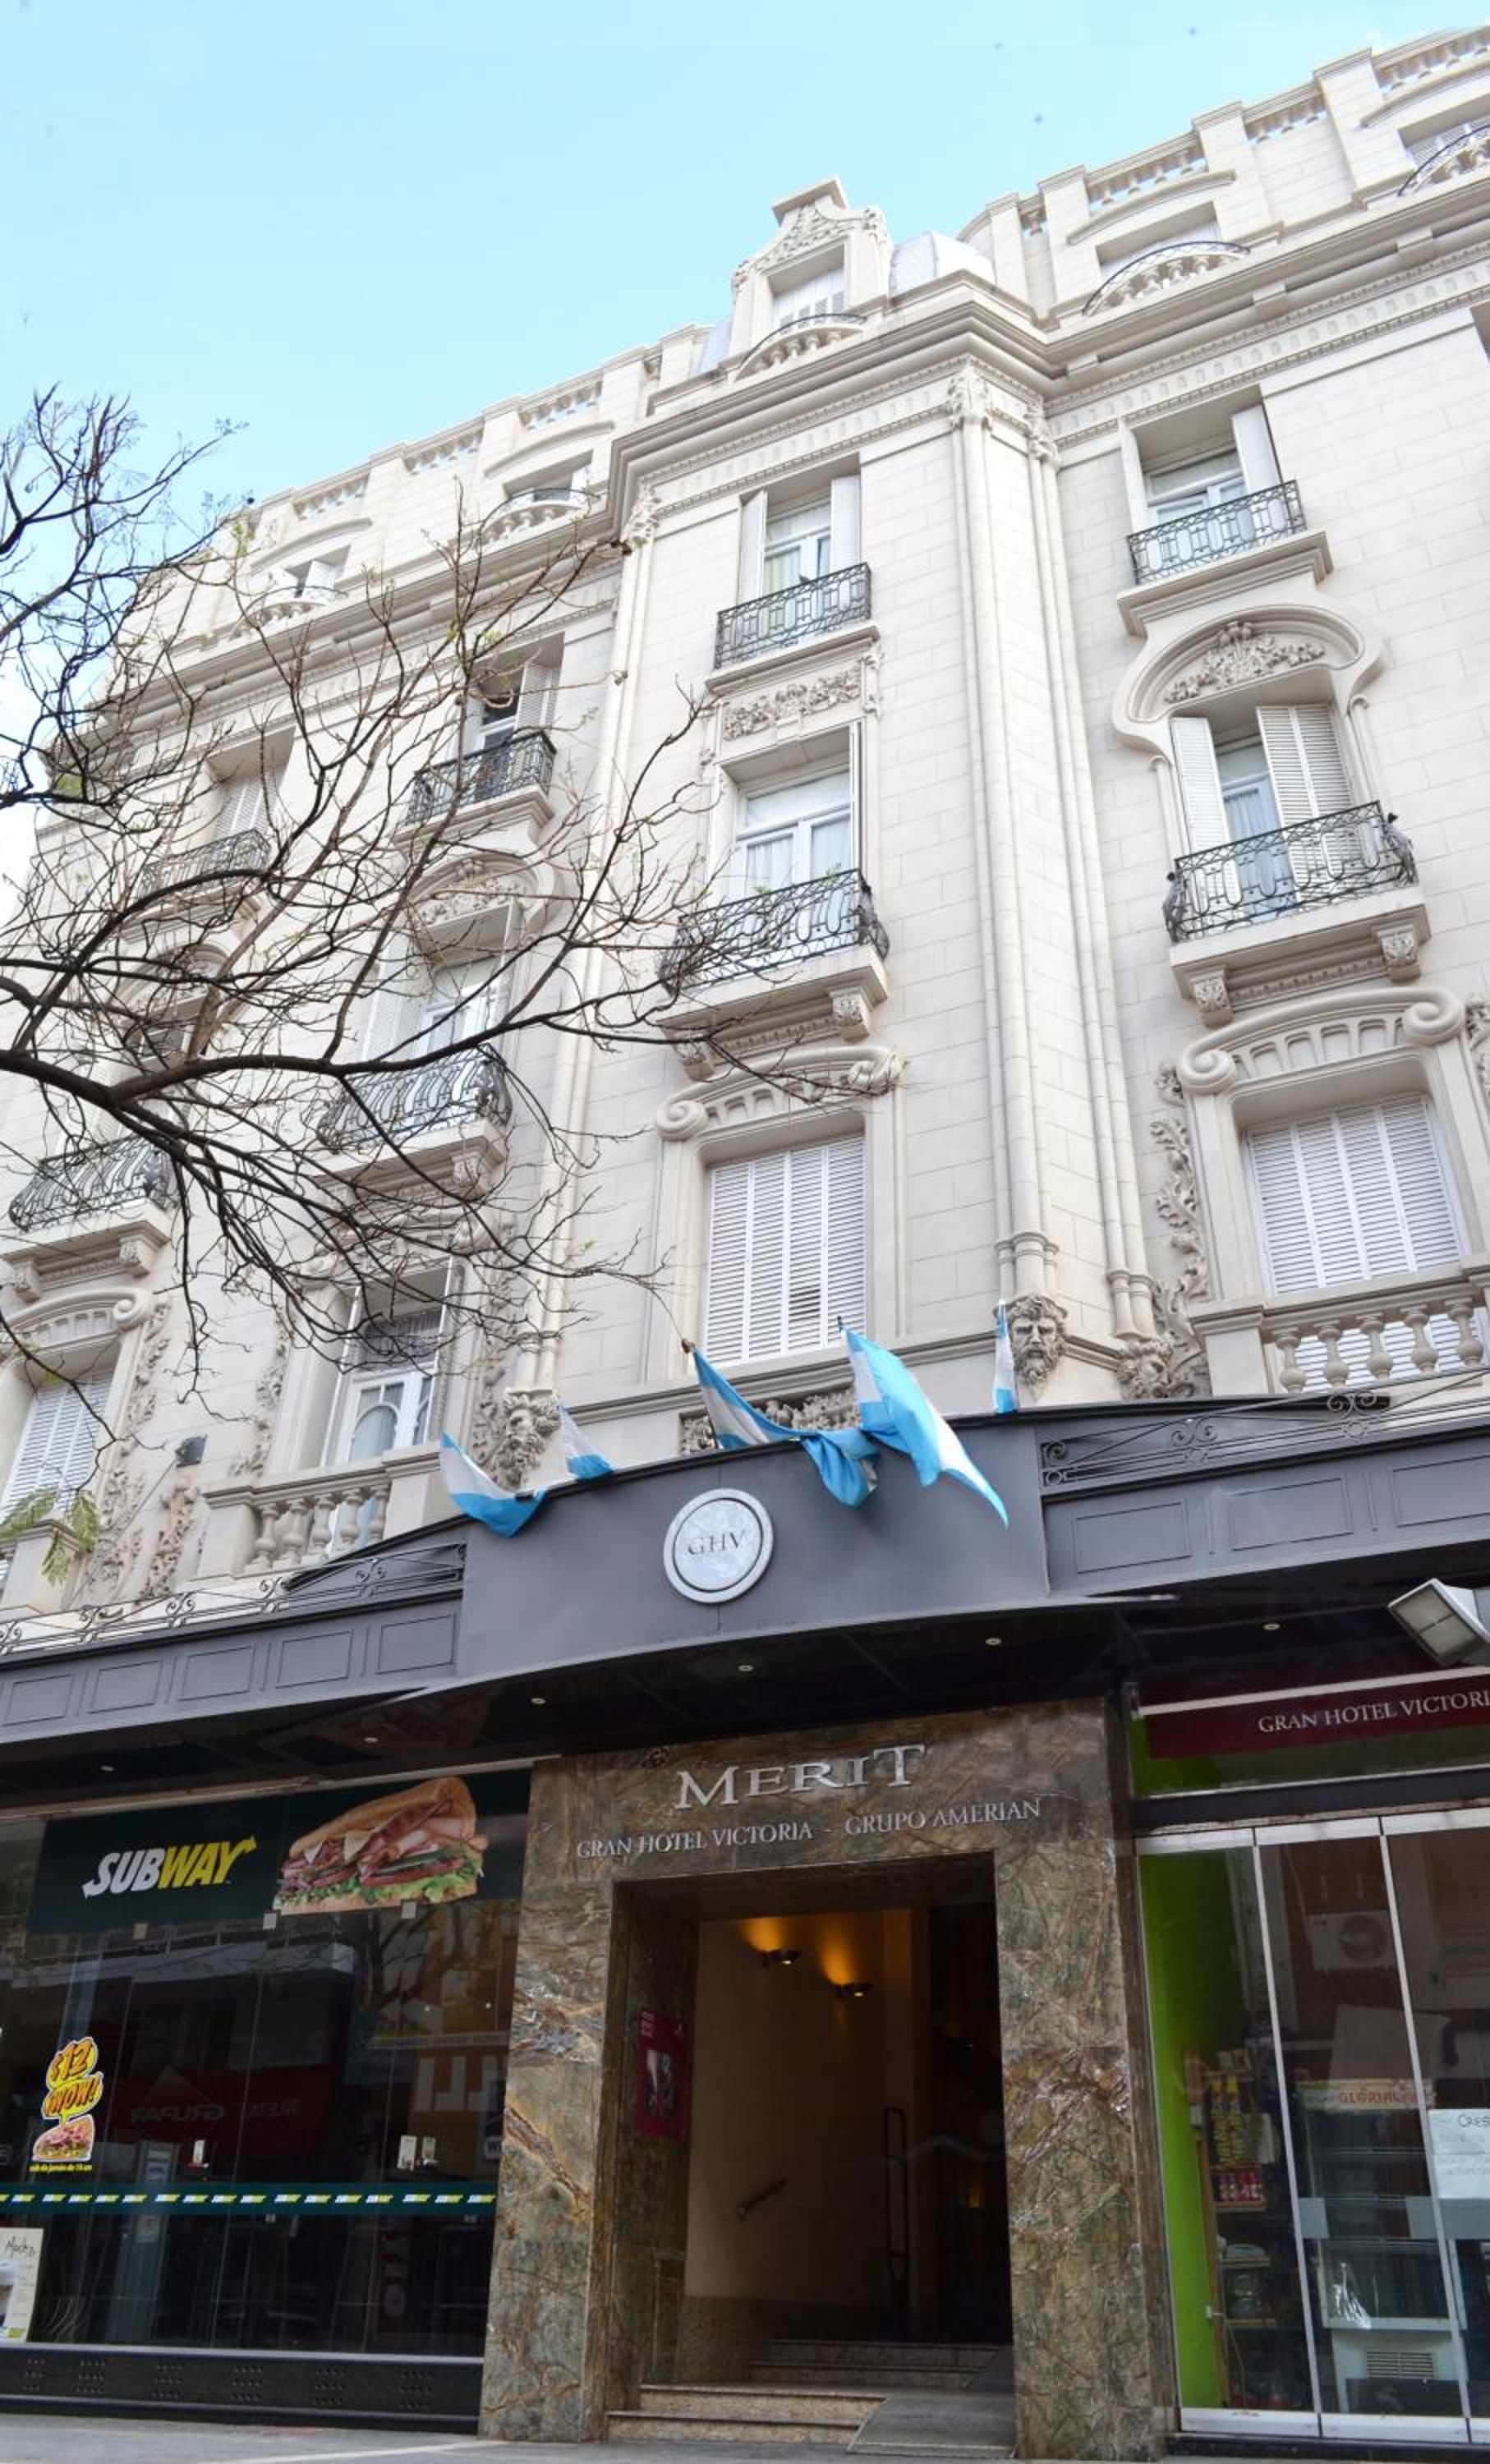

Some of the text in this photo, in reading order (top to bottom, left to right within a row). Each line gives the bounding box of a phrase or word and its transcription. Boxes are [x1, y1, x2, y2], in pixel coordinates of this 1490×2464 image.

[688, 1529, 746, 1555] GHV
[1258, 1712, 1317, 1733] GRAN
[1324, 1702, 1397, 1726] HOTEL
[673, 1743, 926, 1811] MERIT
[577, 1837, 632, 1859] GRAN
[637, 1830, 706, 1853] HOTEL
[711, 1821, 813, 1847] VICTORIA
[844, 1809, 927, 1836] GRUPO
[932, 1797, 1041, 1827] AMERIAN
[82, 1835, 257, 1899] SUBWAY
[47, 2078, 98, 2116] WOW!
